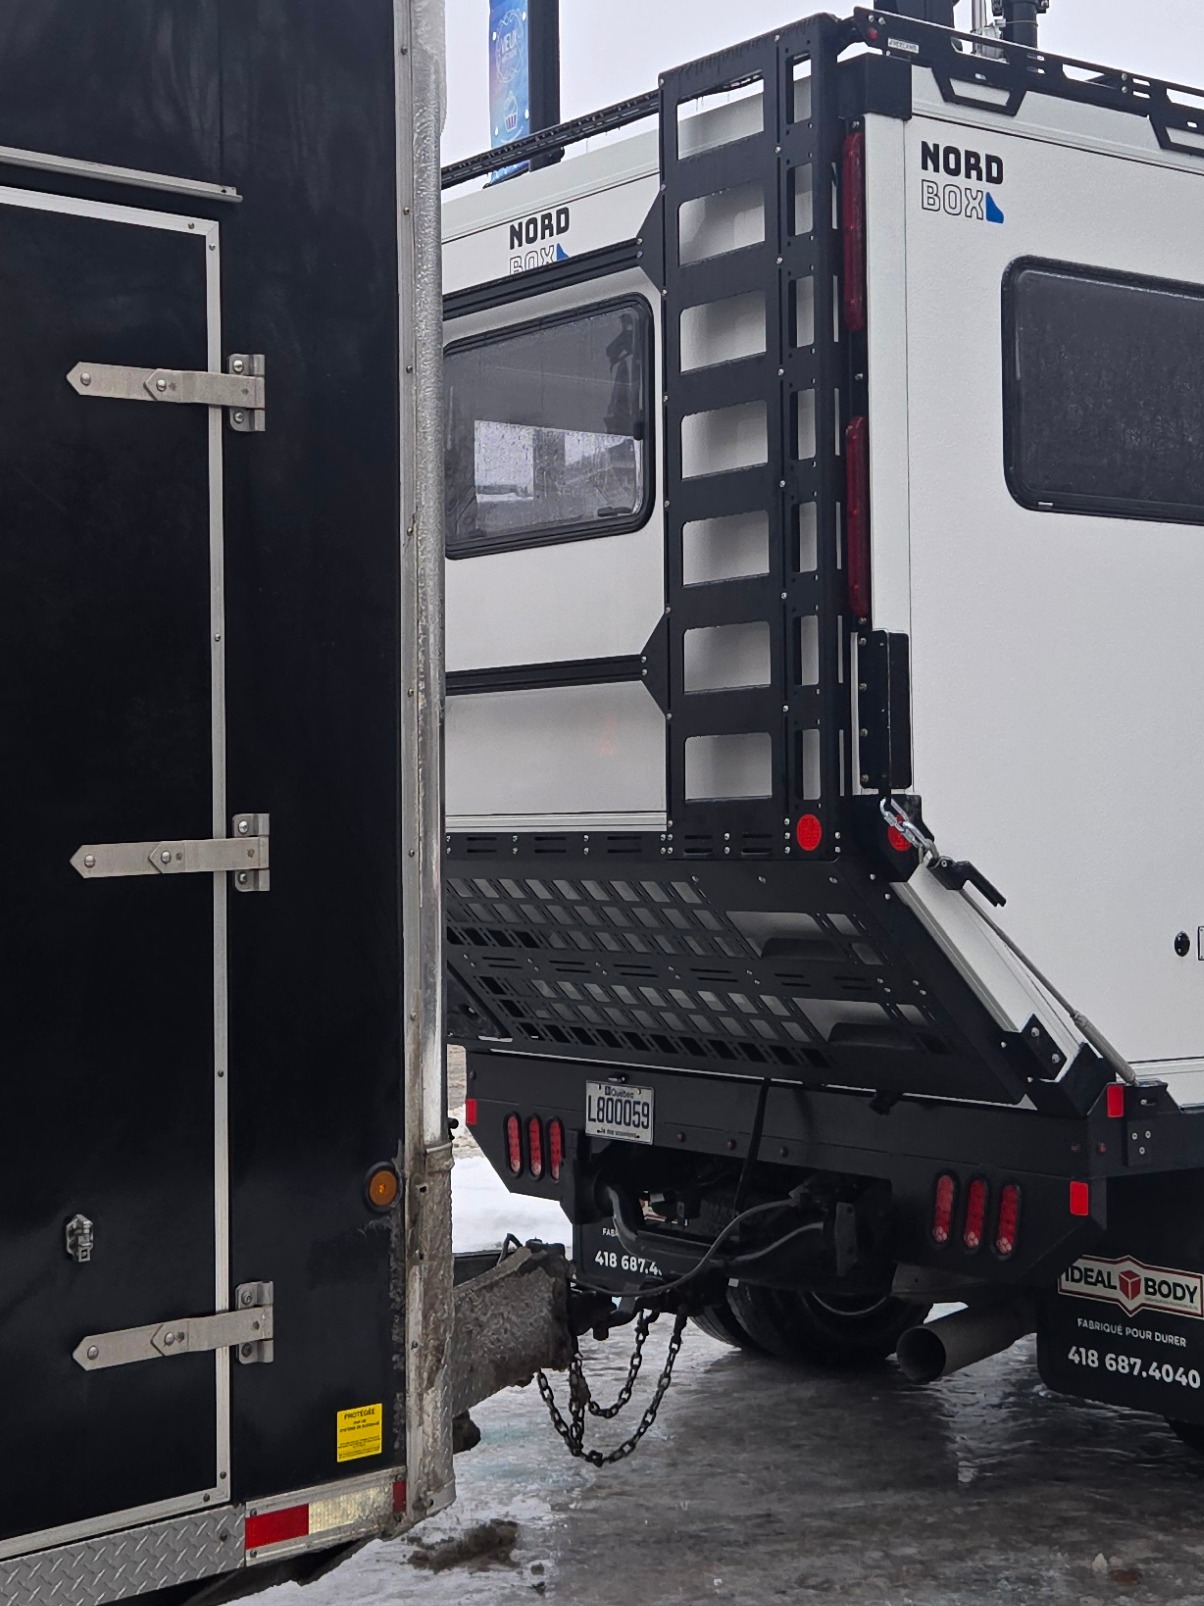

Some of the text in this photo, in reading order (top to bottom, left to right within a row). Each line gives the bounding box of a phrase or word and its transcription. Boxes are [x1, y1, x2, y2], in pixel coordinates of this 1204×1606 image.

[921, 140, 1004, 185] NORD
[921, 178, 984, 221] BOX
[509, 206, 570, 251] NORD
[588, 1095, 650, 1130] L800059
[594, 1250, 663, 1276] 418 687.4
[1065, 1266, 1118, 1291] IDEAL
[1144, 1276, 1198, 1304] BODY
[1077, 1317, 1187, 1348] FABRIQUÉ POUR DURER
[1067, 1346, 1201, 1389] 418 687.4040
